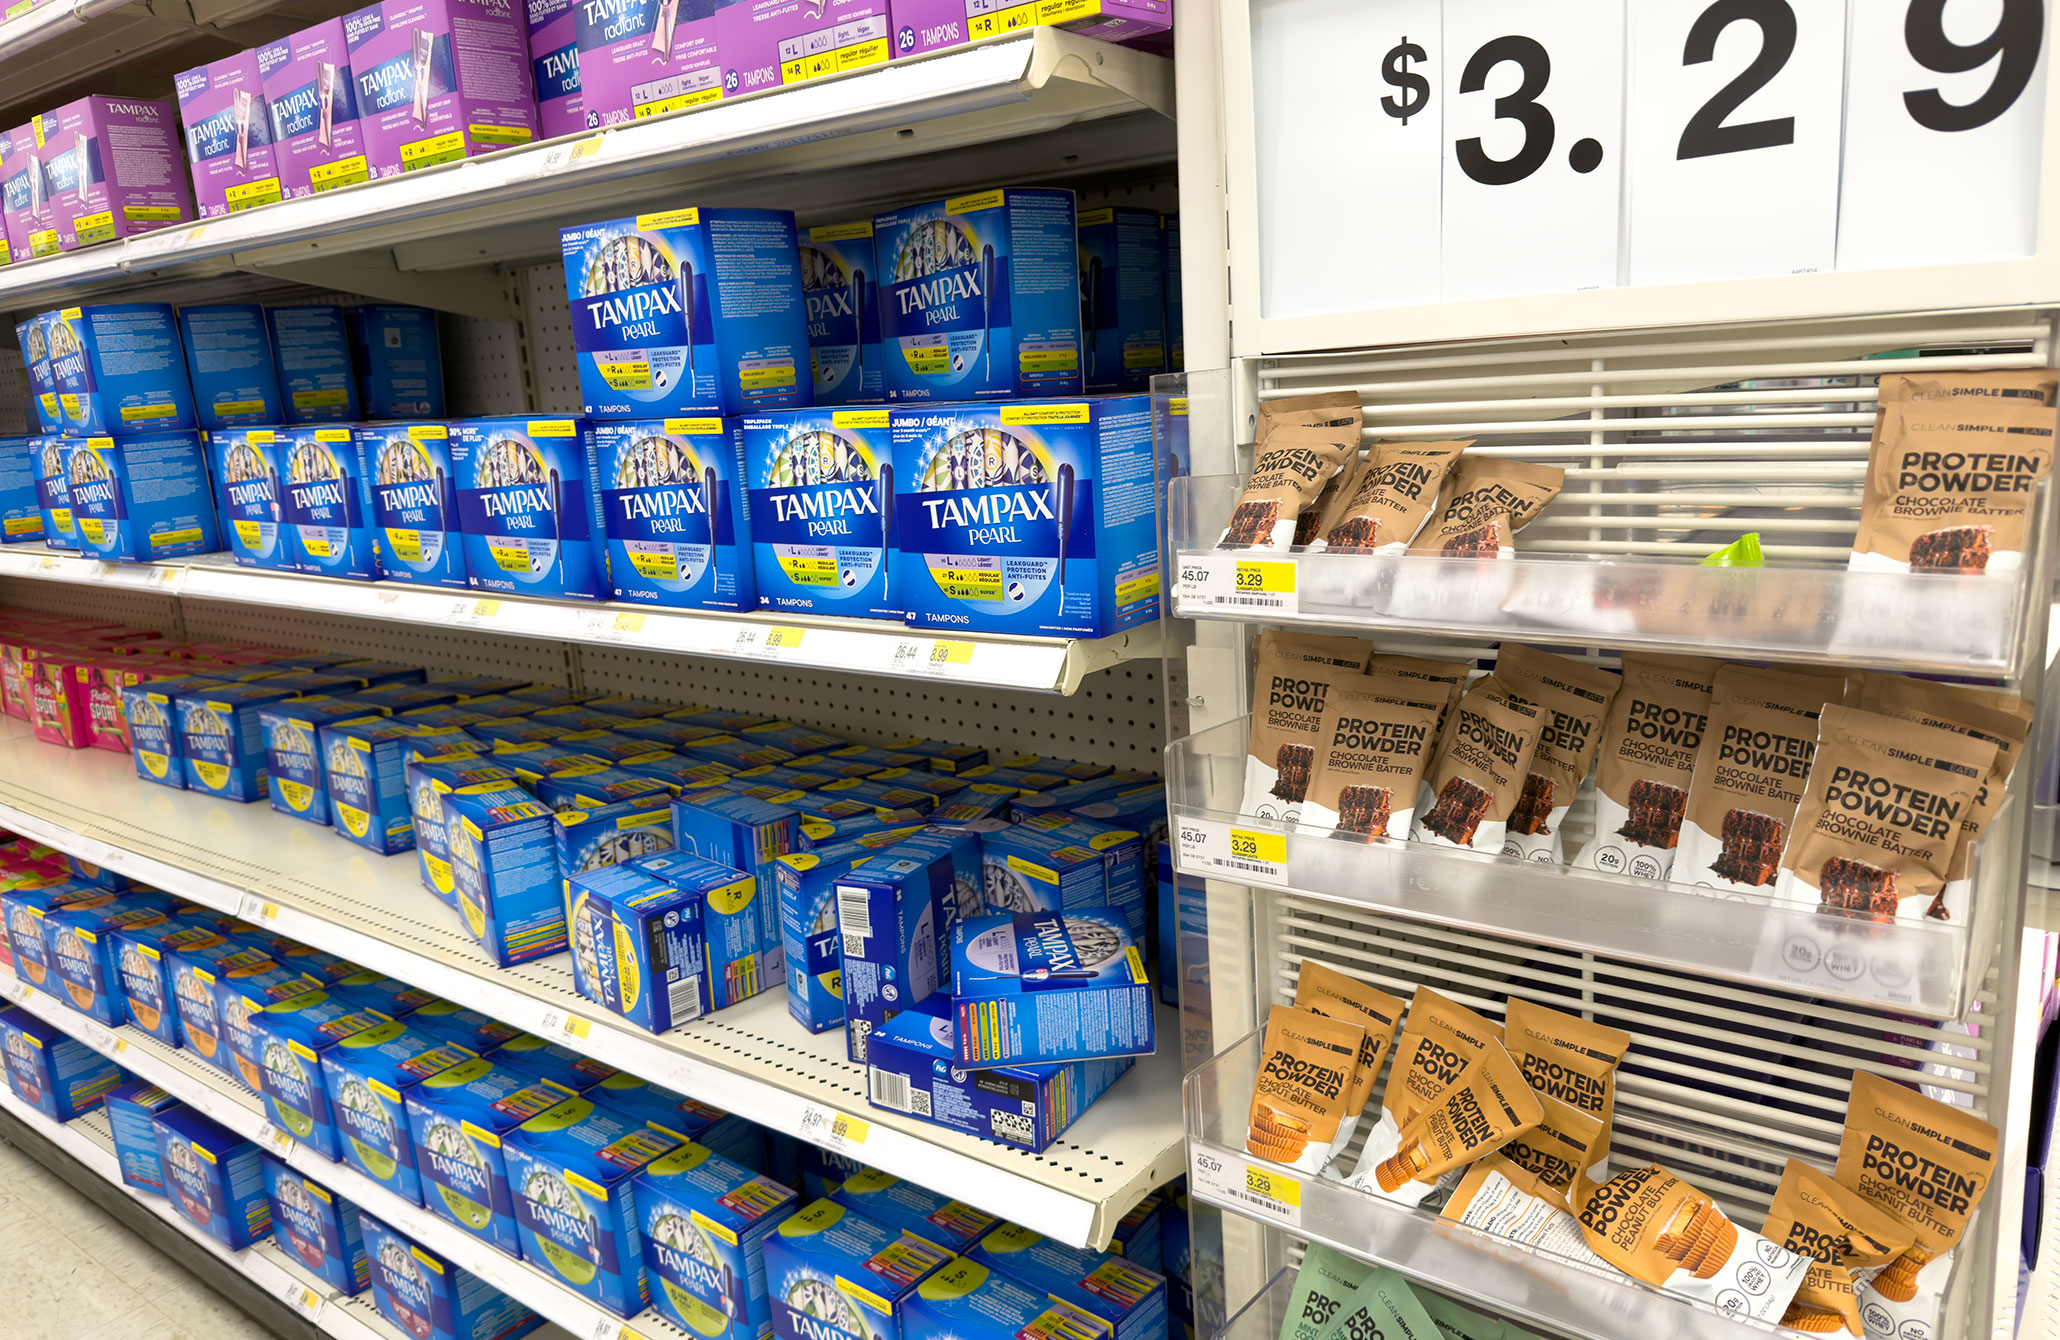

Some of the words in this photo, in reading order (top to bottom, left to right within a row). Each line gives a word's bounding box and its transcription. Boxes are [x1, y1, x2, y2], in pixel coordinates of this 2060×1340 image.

[603, 12, 646, 40] radiant
[899, 31, 914, 49] 26
[921, 22, 959, 47] TAMPONS
[984, 19, 992, 31] R
[840, 48, 859, 60] regular
[858, 45, 879, 56] régulier
[359, 57, 413, 97] TAMPAX
[725, 72, 738, 89] 26
[743, 66, 775, 87] TAMPONS
[794, 64, 801, 75] R
[271, 87, 318, 121] TAMPAX
[376, 86, 407, 109] radiant
[107, 103, 159, 116] TAMPAX
[190, 114, 235, 145] TAMPAX
[561, 233, 581, 243] JUMBO
[895, 268, 981, 315] TAMPAX
[587, 285, 682, 330] TAMPAX
[926, 305, 960, 326] PEARL
[621, 322, 661, 341] PEARL
[53, 354, 84, 381] TAMPAX
[901, 389, 930, 398] TAMPONS
[598, 404, 631, 414] TAMPONS
[595, 426, 613, 435] JUMBO
[892, 418, 920, 428] JUMBO
[926, 415, 955, 428] GÉANT
[1956, 424, 2005, 433] SIMPLE
[1363, 462, 1432, 485] PROTEIN
[1902, 451, 2040, 474] PROTEIN
[72, 481, 112, 505] TAMPAX
[229, 482, 273, 506] TAMPAX
[1898, 472, 2033, 493] POWDER
[291, 483, 343, 510] TAMPAX
[380, 484, 438, 511] TAMPAX
[480, 487, 552, 518] TAMPAX
[619, 487, 706, 520] TAMPAX
[770, 486, 878, 522] TAMPAX
[1896, 495, 1987, 508] CHOCOLATE
[402, 509, 426, 523] PEARL
[922, 488, 1055, 530] TAMPAX
[1893, 505, 1963, 516] BROWNIE
[1967, 507, 2026, 516] BATTER
[506, 516, 536, 531] PEARL
[650, 518, 687, 534] PEARL
[808, 520, 852, 537] PEARL
[968, 526, 1023, 546] PEARL
[947, 557, 953, 566] L
[483, 578, 515, 591] TAMPONS
[948, 571, 955, 581] R
[1182, 571, 1209, 582] 45.07
[1236, 573, 1263, 586] 3.29
[628, 589, 658, 600] TAMPONS
[759, 596, 770, 605] 34
[776, 597, 813, 608] TAMPONS
[949, 586, 956, 595] S
[906, 611, 917, 621] 47
[926, 613, 970, 625] TAMPONS
[895, 645, 917, 660] 26.44
[930, 648, 949, 662] 8.99
[1302, 654, 1332, 665] SIMPLE
[34, 696, 58, 717] SPORT
[89, 701, 118, 723] SPORT
[1374, 696, 1407, 707] SIMPLE
[1267, 717, 1310, 732] BROWNIE
[1268, 709, 1321, 725] CHOCOLATE
[133, 725, 166, 743] TAMPAX
[1336, 717, 1427, 741] PROTEIN
[1460, 709, 1524, 754] PROTEIN
[188, 735, 227, 753] TAMPAX
[1332, 733, 1422, 757] POWDER
[1458, 722, 1517, 770] POWDER
[1622, 738, 1693, 762] CHOCOLATE
[275, 752, 313, 771] TAMPAX
[1328, 758, 1373, 772] BROWNIE
[1375, 764, 1413, 776] BATTER
[1330, 750, 1389, 765] CHOCOLATE
[1618, 746, 1674, 768] BROWNIE
[1887, 747, 1934, 767] SIMPLE
[331, 773, 368, 796] TAMPAX
[1713, 775, 1765, 796] BROWNIE
[1717, 765, 1782, 789] CHOCOLATE
[1830, 766, 1961, 821] PROTEIN
[1825, 785, 1951, 841] POWDER
[1821, 809, 1902, 842] CHOCOLATE
[1181, 831, 1207, 844] 45.07
[1232, 840, 1257, 854] 3.29
[1816, 819, 1879, 846] BROWNIE
[1881, 839, 1933, 861] BATTER
[1600, 853, 1619, 865] 20g
[1635, 860, 1657, 872] 100%
[1033, 918, 1078, 972] TAMPAX
[59, 955, 90, 977] TAMPAX
[594, 917, 615, 1005] TAMPAX
[122, 973, 157, 998] TAMPAX
[179, 998, 213, 1022] TAMPAX
[892, 1035, 934, 1051] TAMPONS
[1306, 1036, 1332, 1050] SIMPLE
[1455, 1030, 1486, 1050] SIMPLE
[1553, 1038, 1588, 1055] SIMPLE
[1270, 1051, 1344, 1088] PROTEIN
[1523, 1052, 1606, 1095] PROTEIN
[265, 1069, 308, 1100] TAMPAX
[1258, 1075, 1311, 1101] CHOCOLATE
[1263, 1062, 1340, 1101] POWDER
[1255, 1083, 1290, 1100] PEANUT
[1290, 1092, 1327, 1116] BUTTER
[342, 1107, 390, 1142] TAMPAX
[1445, 1095, 1478, 1151] POWDER
[1456, 1086, 1495, 1142] PROTEIN
[831, 1120, 848, 1136] 8.99
[1436, 1108, 1455, 1144] CHOCOLATE
[1910, 1123, 1953, 1145] SIMPLE
[428, 1152, 486, 1188] TAMPAX
[1197, 1157, 1223, 1173] 45.07
[1246, 1174, 1271, 1192] 3.29
[1866, 1134, 1976, 1198] PROTEIN
[169, 1164, 206, 1193] TAMPAX
[1862, 1153, 1969, 1216] POWDER
[1593, 1167, 1661, 1237] POWDER
[1859, 1174, 1934, 1217] CHOCOLATE
[279, 1203, 319, 1234] TAMPAX
[526, 1199, 591, 1243] TAMPAX
[1611, 1184, 1657, 1245] CHOCOLATE
[1620, 1209, 1650, 1252] PEANUT
[1647, 1177, 1680, 1209] BUTTER
[1858, 1183, 1907, 1217] PEANUT
[1906, 1208, 1955, 1239] BUTTER
[653, 1243, 723, 1293] TAMPAX
[381, 1268, 427, 1306] TAMPAX
[1297, 1322, 1320, 1337] MINT
[1910, 1328, 1924, 1336] NO
